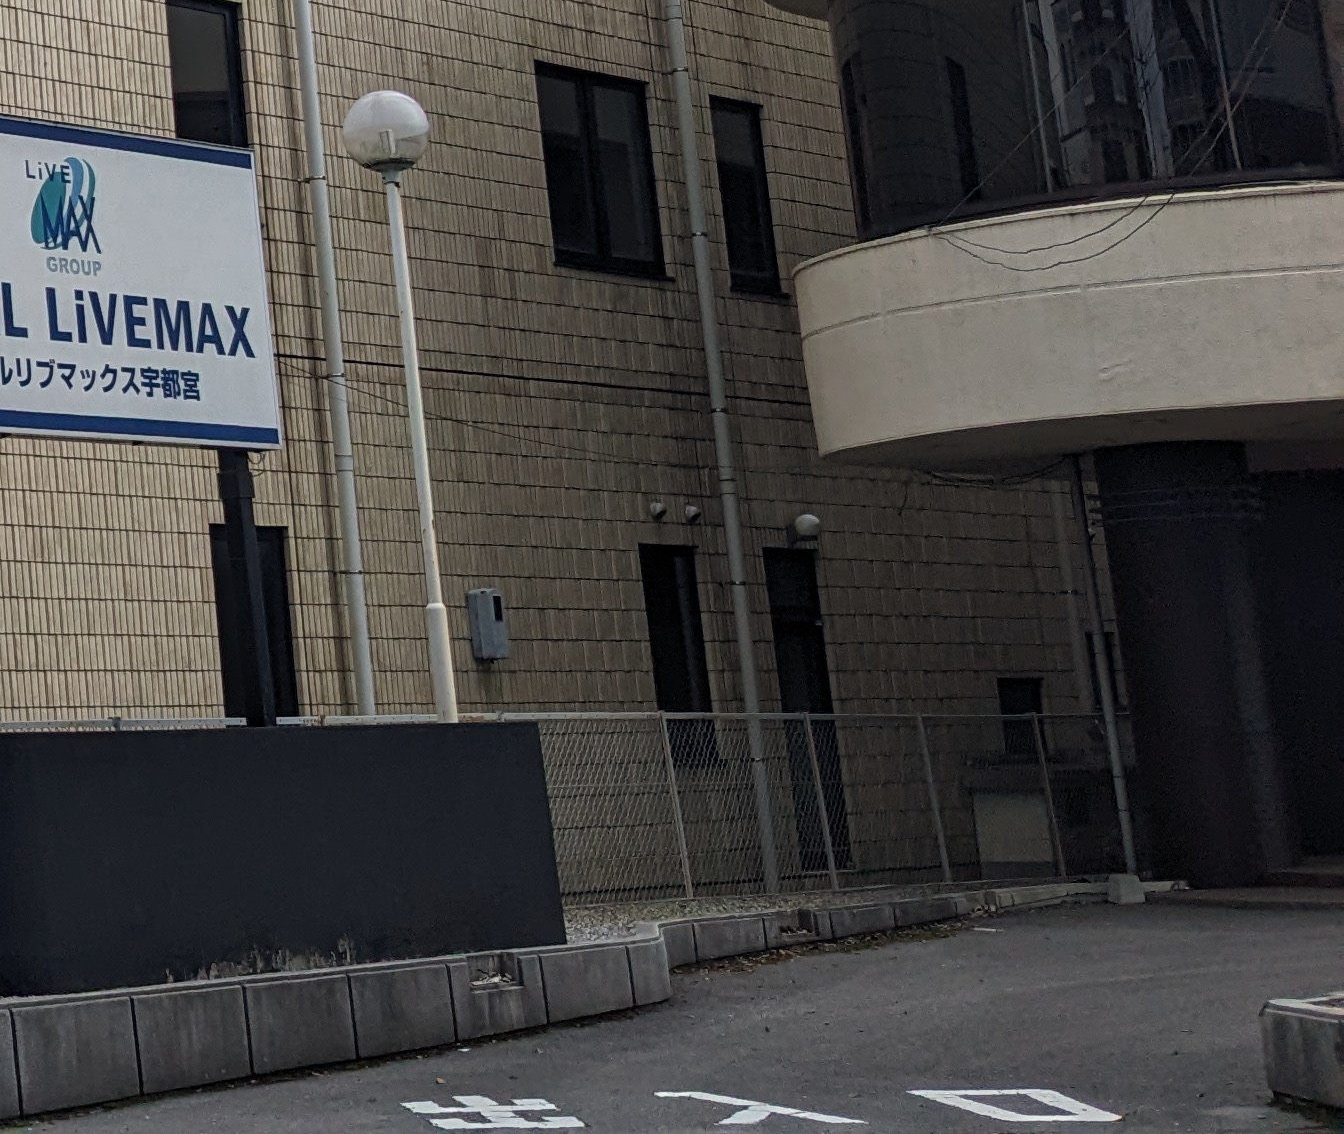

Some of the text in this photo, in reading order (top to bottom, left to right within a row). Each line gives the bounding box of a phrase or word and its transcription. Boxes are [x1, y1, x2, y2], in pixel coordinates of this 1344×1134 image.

[40, 190, 102, 254] MAX
[46, 256, 102, 276] GROUP
[44, 286, 256, 358] LiVEMAX
[399, 1089, 1125, 1130] 出入口
